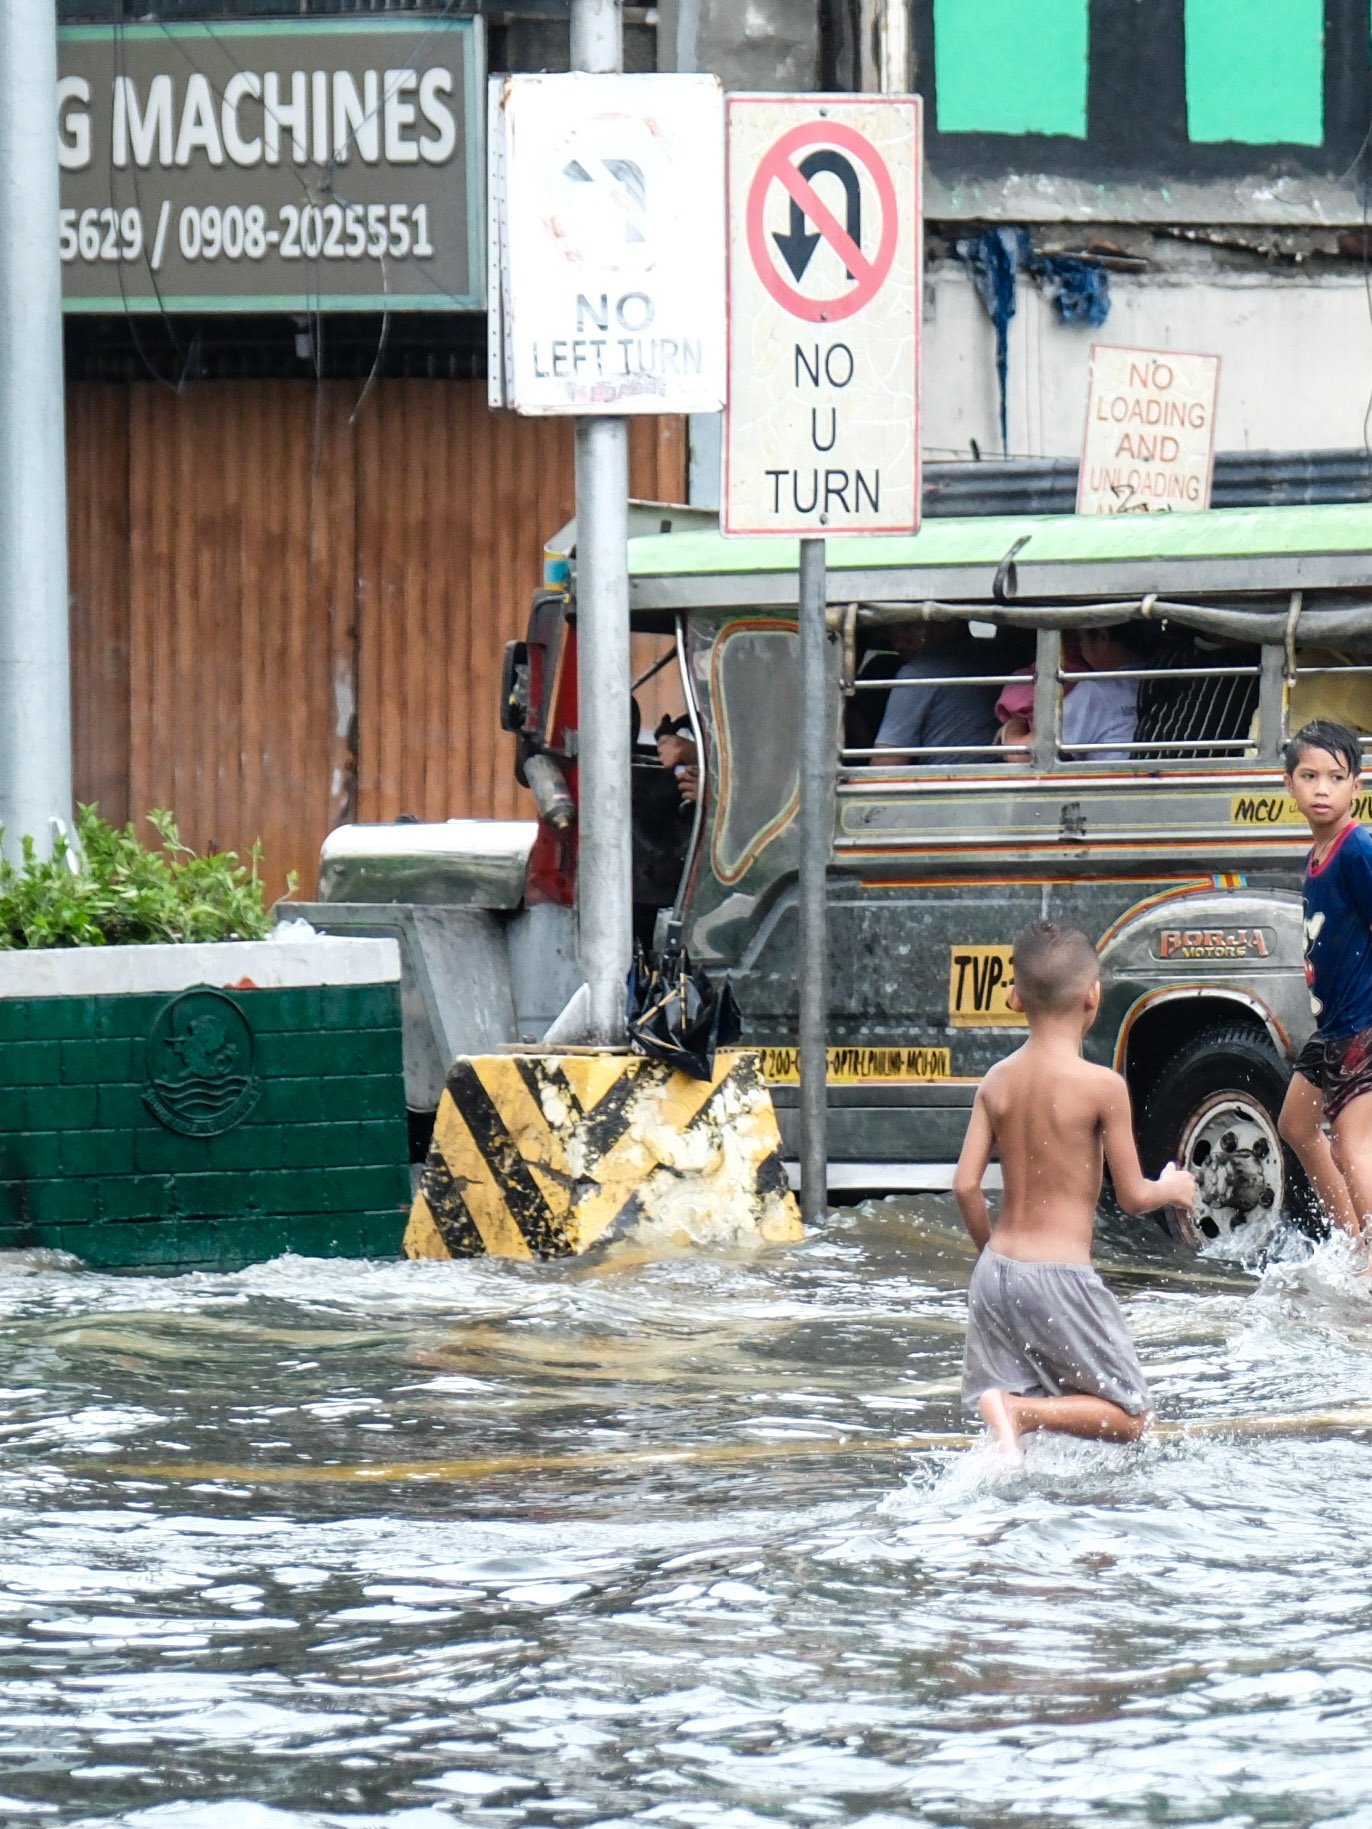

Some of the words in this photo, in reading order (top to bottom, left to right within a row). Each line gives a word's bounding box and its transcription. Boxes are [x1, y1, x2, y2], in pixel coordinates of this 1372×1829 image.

[112, 66, 456, 168] MACHINES
[60, 206, 144, 261] 5629
[178, 202, 434, 260] 0908-2025551
[576, 291, 655, 332] NO
[532, 339, 607, 379] LEFT
[616, 338, 704, 376] TURN
[794, 342, 854, 388] NO
[1129, 361, 1174, 389] NO
[811, 406, 836, 452] U
[1096, 395, 1205, 428] LOADING
[1114, 432, 1180, 462] AND
[764, 468, 880, 514] TURN
[1089, 465, 1200, 501] UNLOADING
[1234, 798, 1284, 823] MCU
[1159, 928, 1269, 960] BORJA
